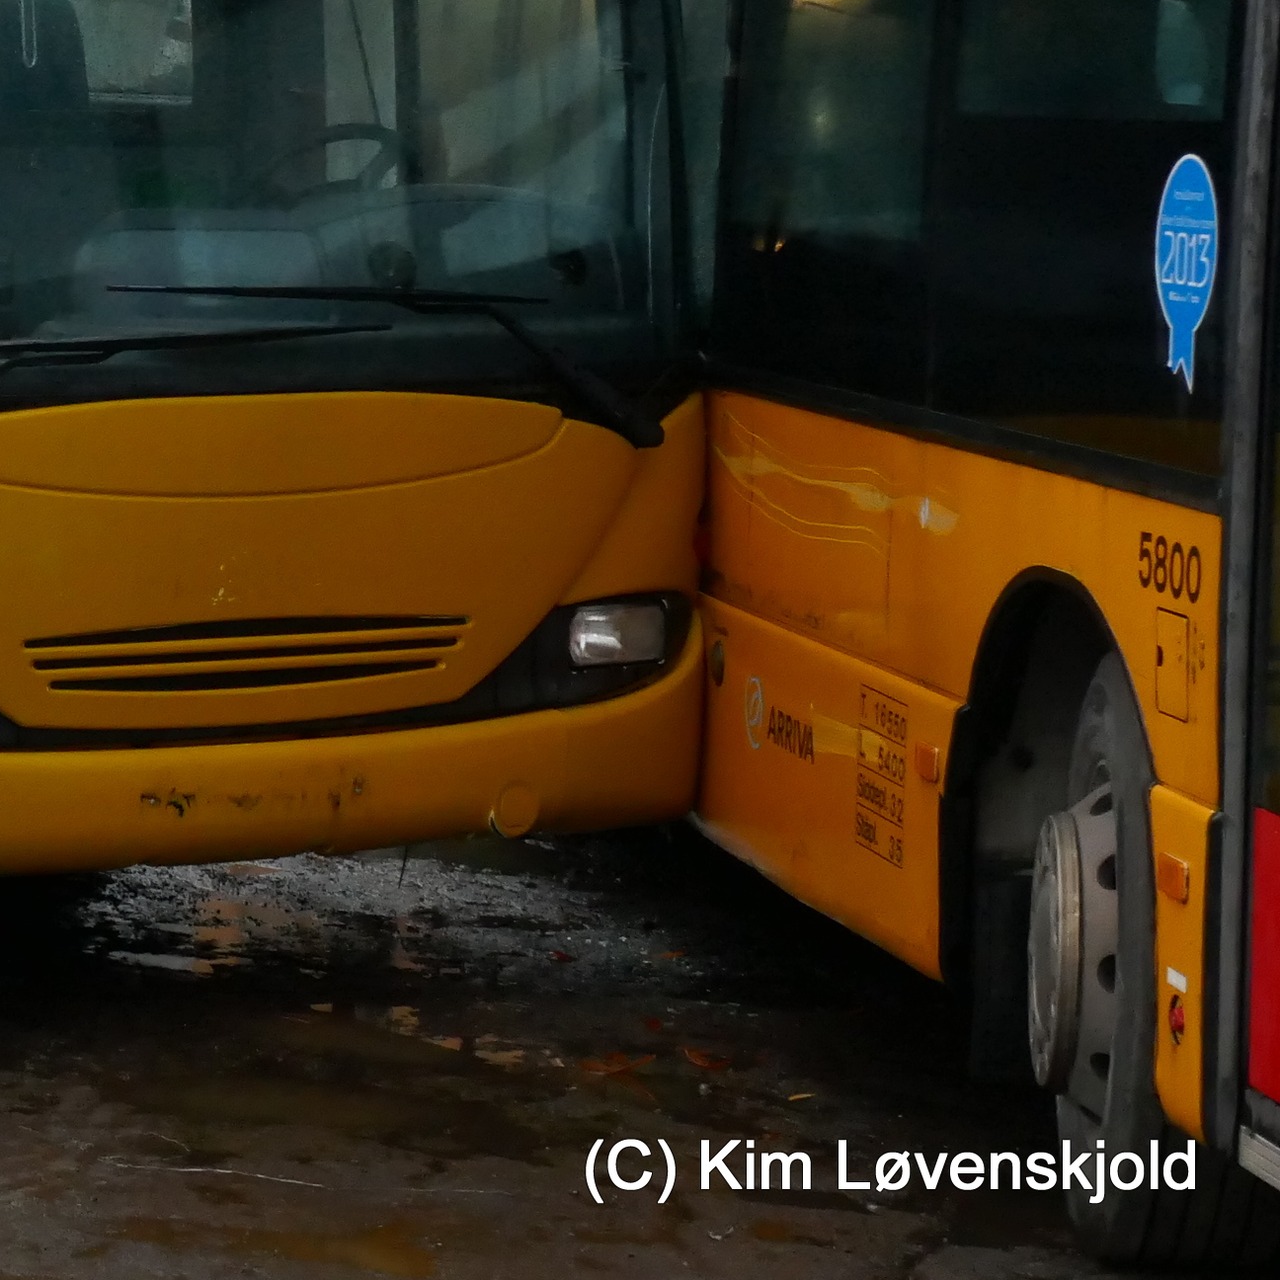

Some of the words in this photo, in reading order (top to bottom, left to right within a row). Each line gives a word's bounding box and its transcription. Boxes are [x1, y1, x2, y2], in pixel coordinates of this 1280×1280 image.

[1161, 230, 1211, 288] 2013
[1138, 531, 1202, 604] 5800
[767, 705, 815, 765] ARRIVA
[874, 701, 907, 742] 16550
[878, 746, 906, 782] 5400
[890, 793, 904, 823] 32
[888, 835, 903, 864] 35
